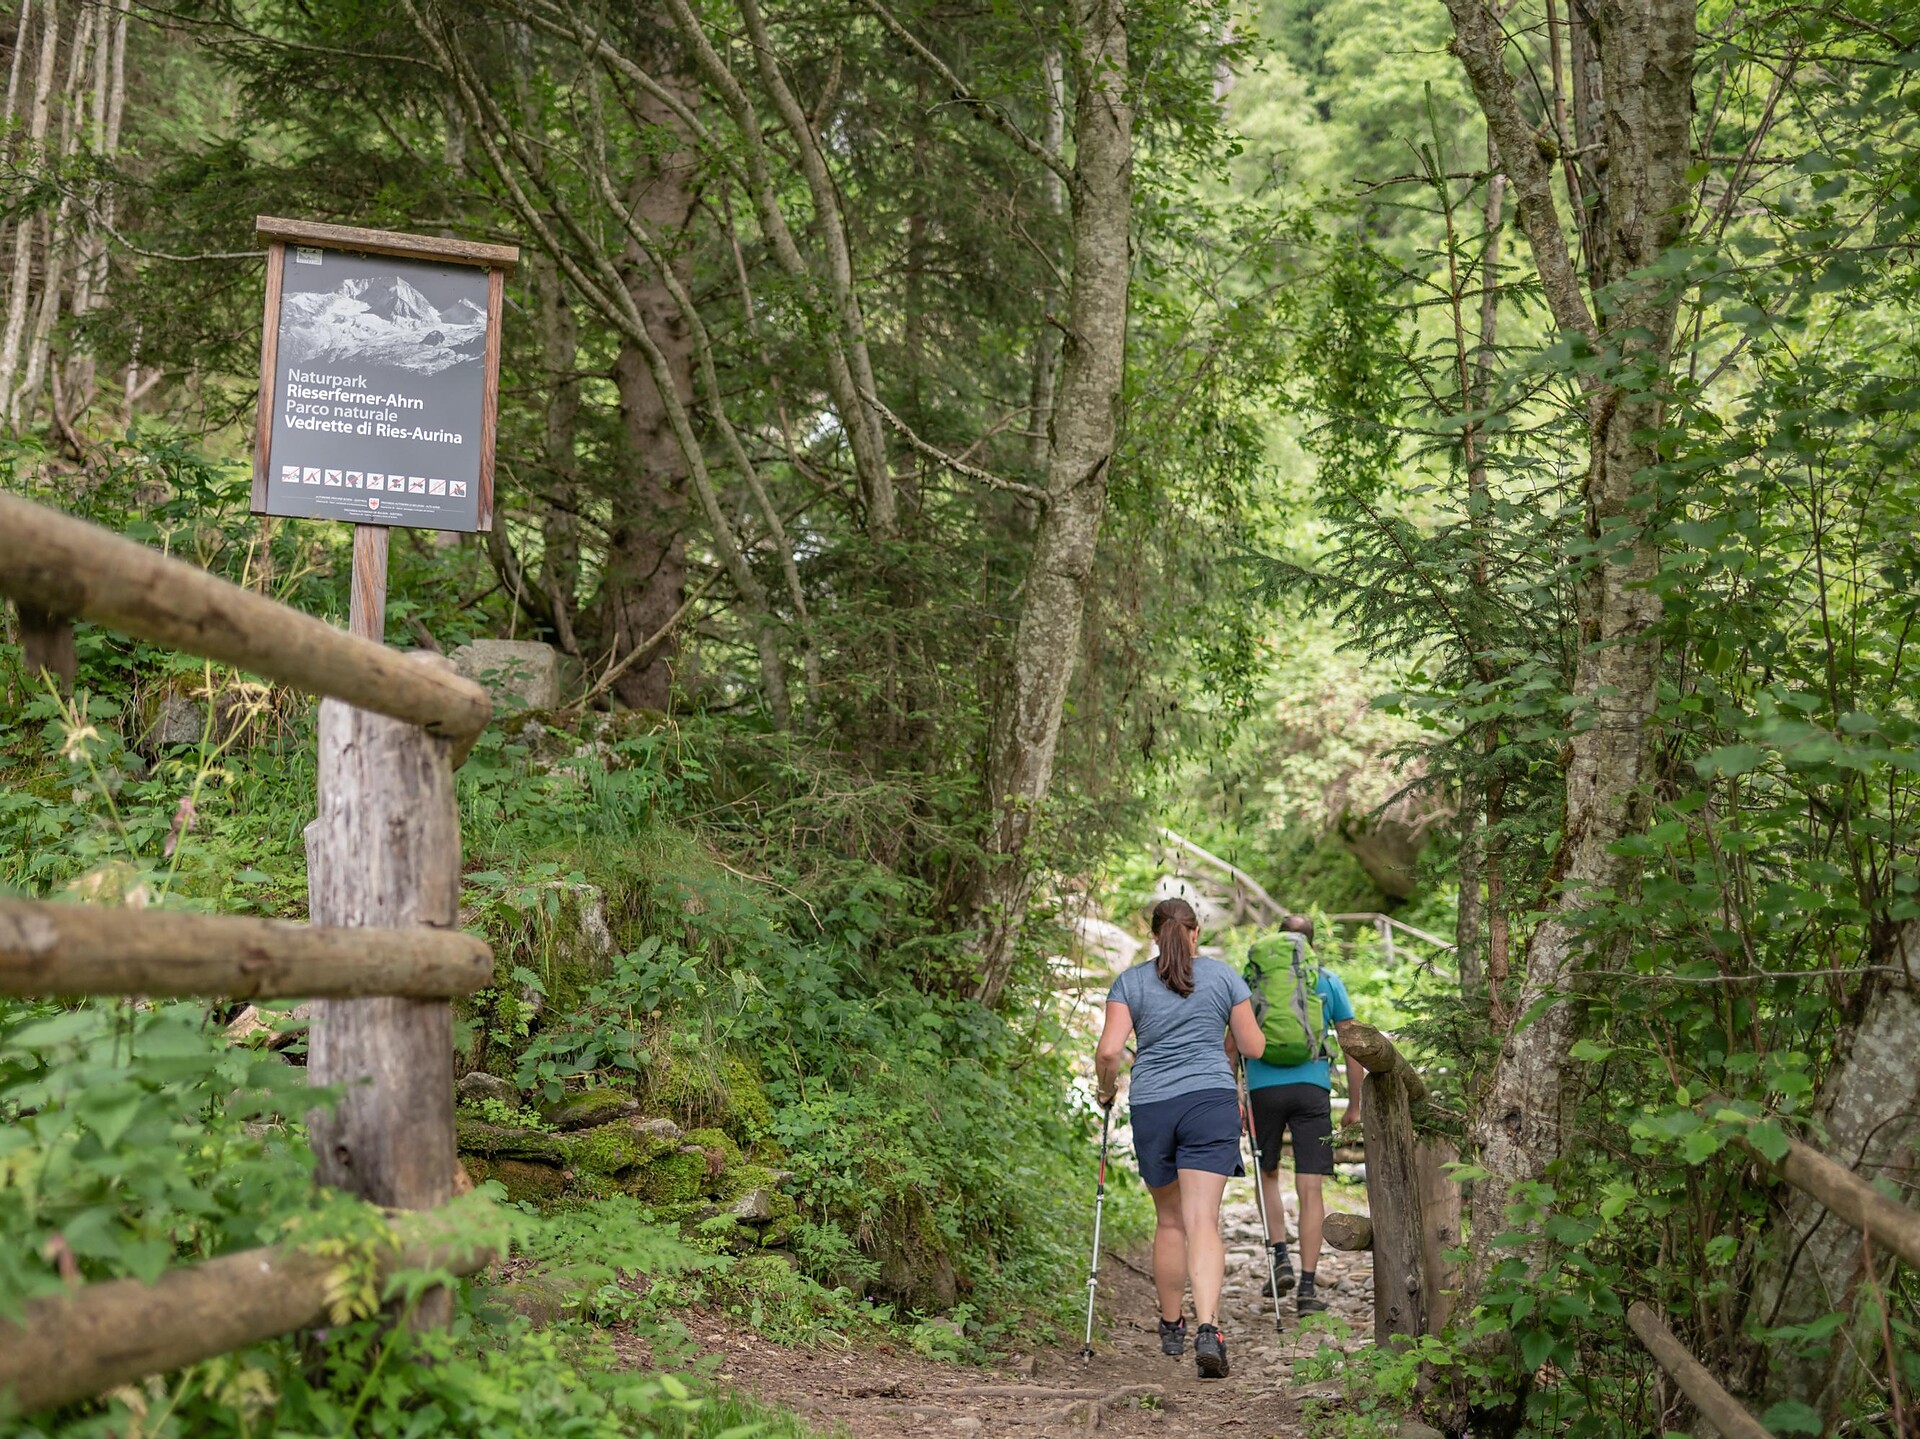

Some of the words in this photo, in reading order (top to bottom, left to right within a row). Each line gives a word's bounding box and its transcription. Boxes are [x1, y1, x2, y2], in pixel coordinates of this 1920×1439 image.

[288, 368, 368, 389] Naturpark
[287, 383, 424, 410] Rieserferner-Ahrn
[286, 399, 329, 416] Parco
[333, 406, 398, 422] naturale
[285, 414, 353, 433] Vedrette
[356, 421, 371, 436] di
[376, 423, 462, 444] Ries-Aurina
